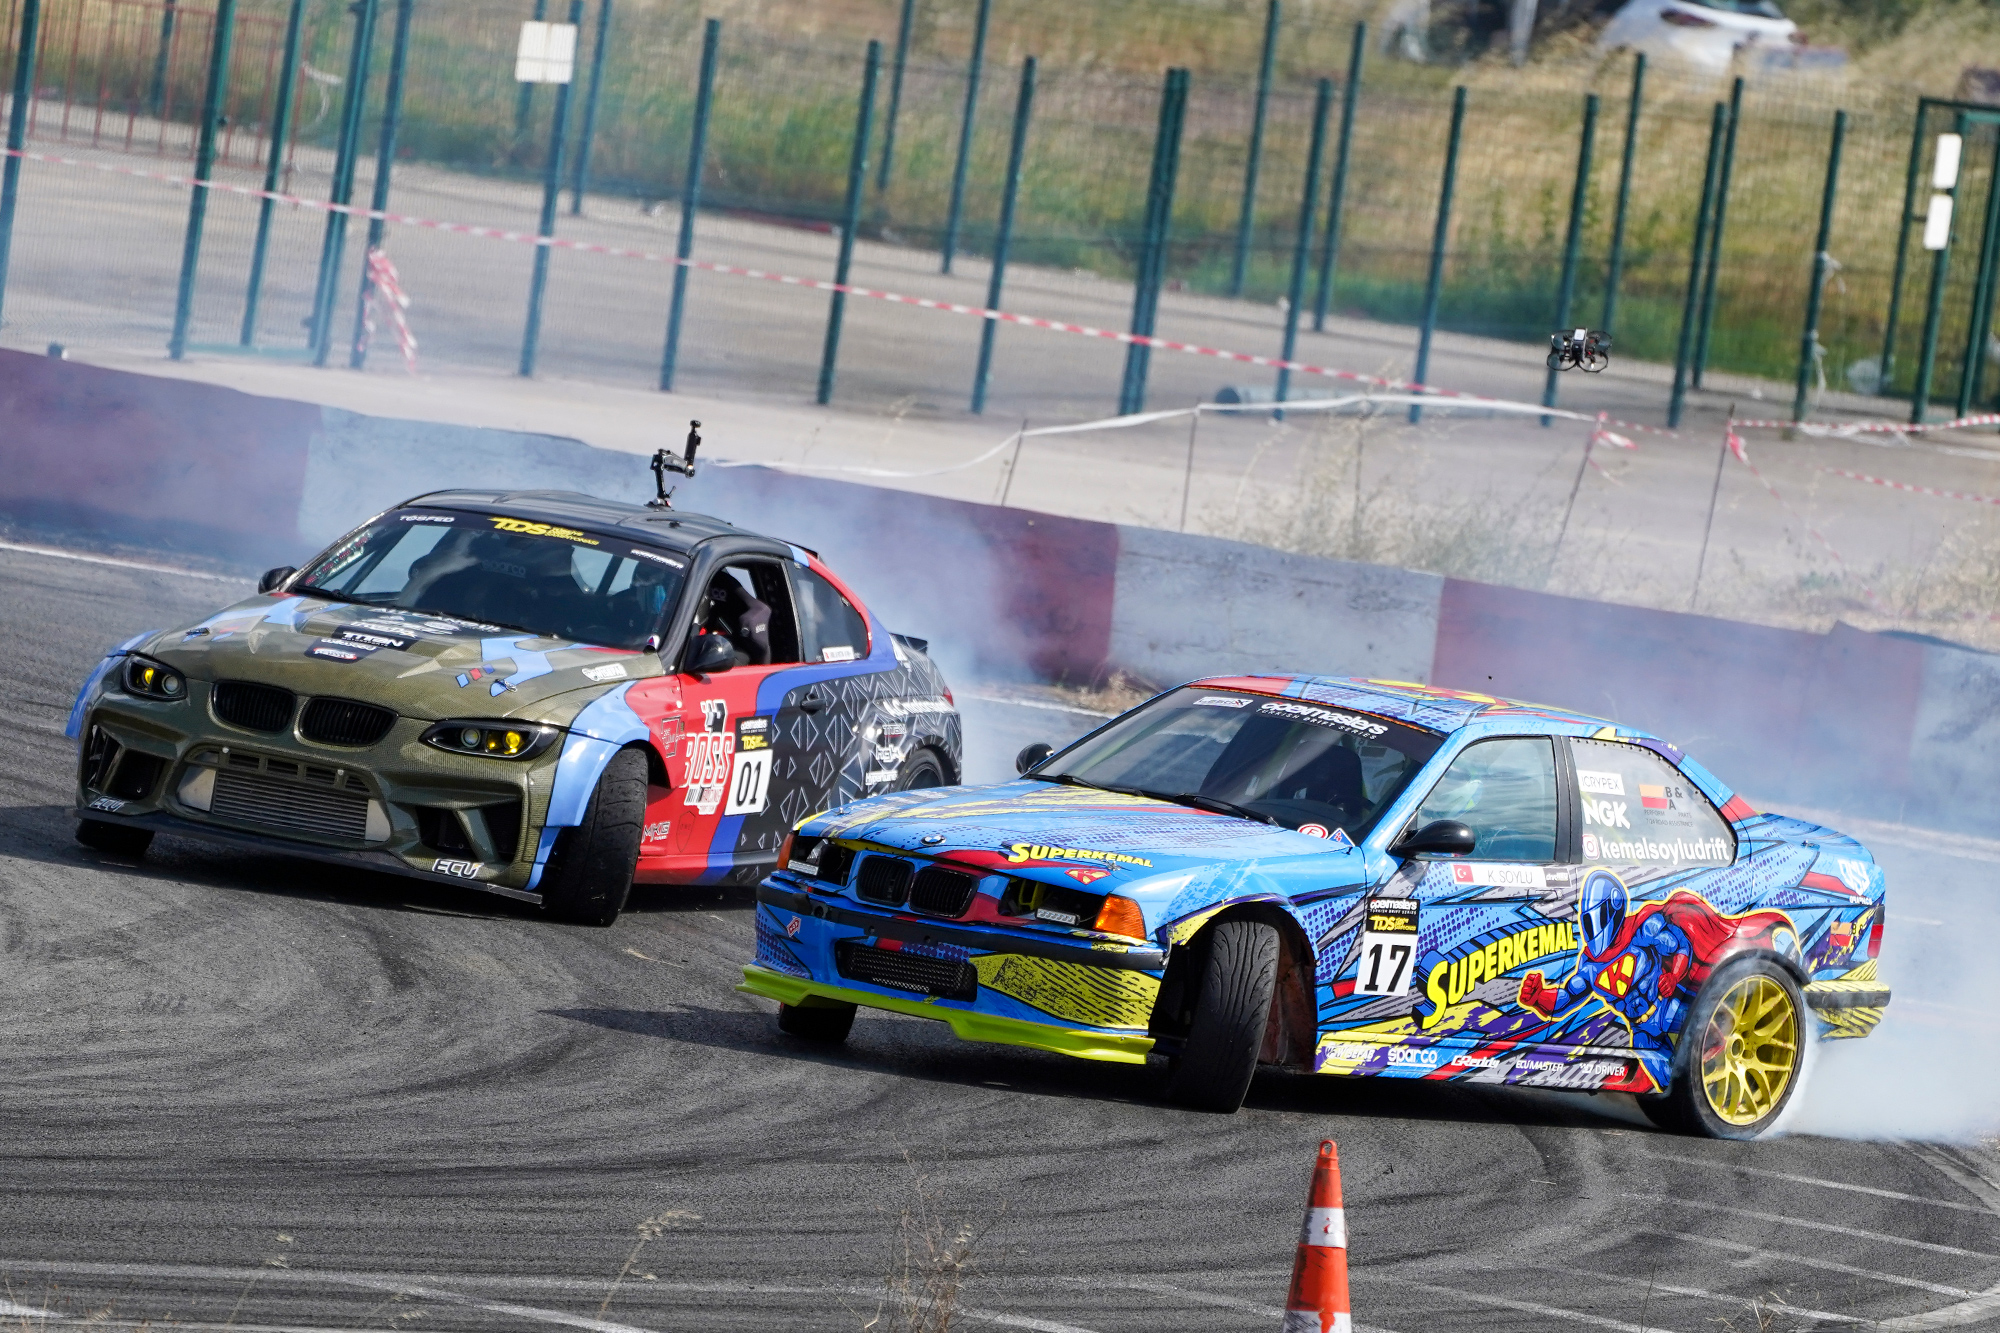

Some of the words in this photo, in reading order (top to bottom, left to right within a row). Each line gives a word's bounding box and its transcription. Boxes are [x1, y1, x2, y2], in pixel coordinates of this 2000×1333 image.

[400, 515, 456, 523] TOSFED
[487, 516, 551, 535] TDS
[1255, 708, 1300, 719] TURKISH
[1303, 716, 1335, 728] DRIFT
[1338, 725, 1377, 740] SERIES
[679, 732, 735, 788] BOSS
[736, 761, 762, 807] 01
[1665, 786, 1673, 798] B
[1675, 787, 1683, 799] &
[92, 796, 124, 812] ECU
[1669, 799, 1677, 811] A
[1581, 798, 1631, 830] NGK
[1007, 842, 1154, 868] SUPERKEMAL
[1599, 836, 1730, 865] kemalsoyludrift
[432, 858, 484, 879] ECU
[1500, 870, 1533, 884] SOYLU
[1369, 915, 1395, 931] TDS
[1364, 943, 1412, 993] 17
[1421, 921, 1578, 1030] SUPERKEMAL
[1387, 1047, 1438, 1066] sparco
[1450, 1054, 1501, 1069] GReddy
[1595, 1064, 1626, 1077] DRIVER
